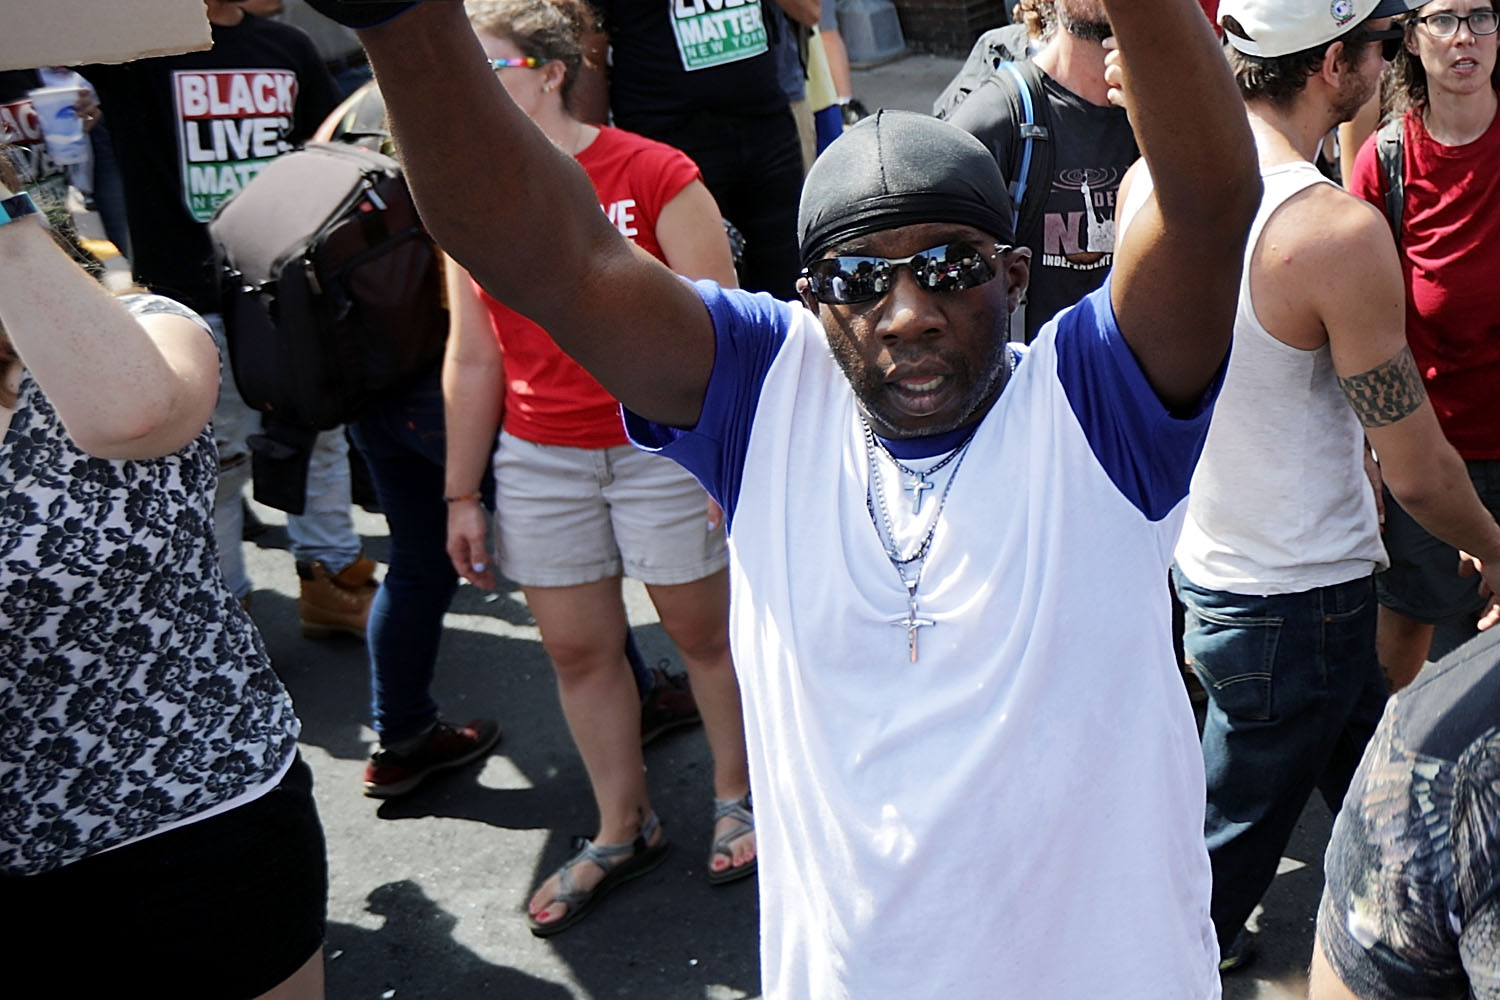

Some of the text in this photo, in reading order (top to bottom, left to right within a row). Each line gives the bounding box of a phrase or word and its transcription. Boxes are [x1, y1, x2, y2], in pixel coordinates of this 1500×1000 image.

[679, 3, 760, 47] MATTER
[686, 40, 724, 58] NEW
[179, 73, 294, 117] BLACK
